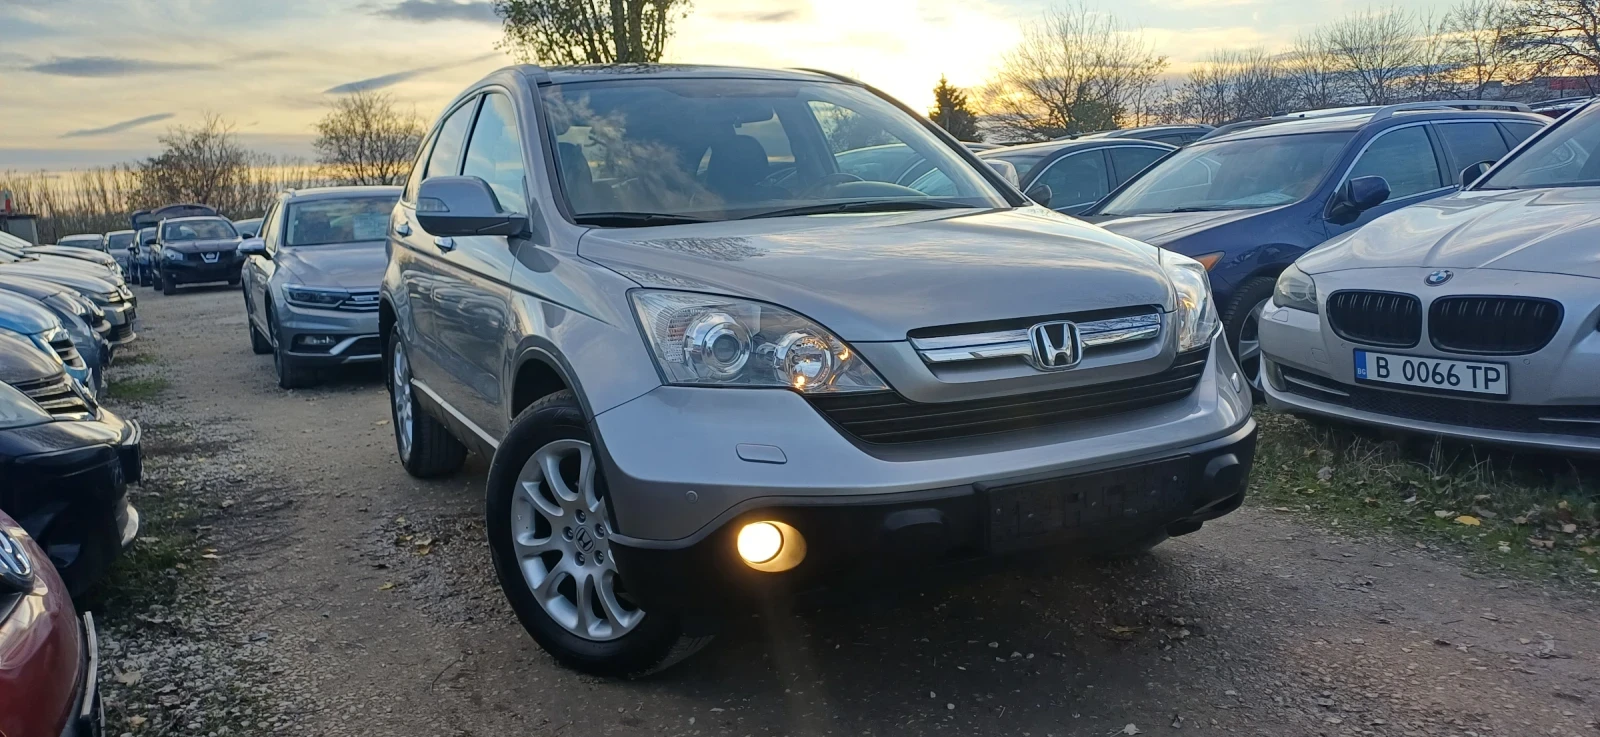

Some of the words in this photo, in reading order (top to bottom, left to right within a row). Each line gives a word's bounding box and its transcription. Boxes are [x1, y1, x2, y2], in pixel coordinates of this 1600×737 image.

[1357, 367, 1367, 375] BG
[1376, 356, 1390, 378] B
[1402, 359, 1461, 387] 0066
[1466, 364, 1501, 390] TP
